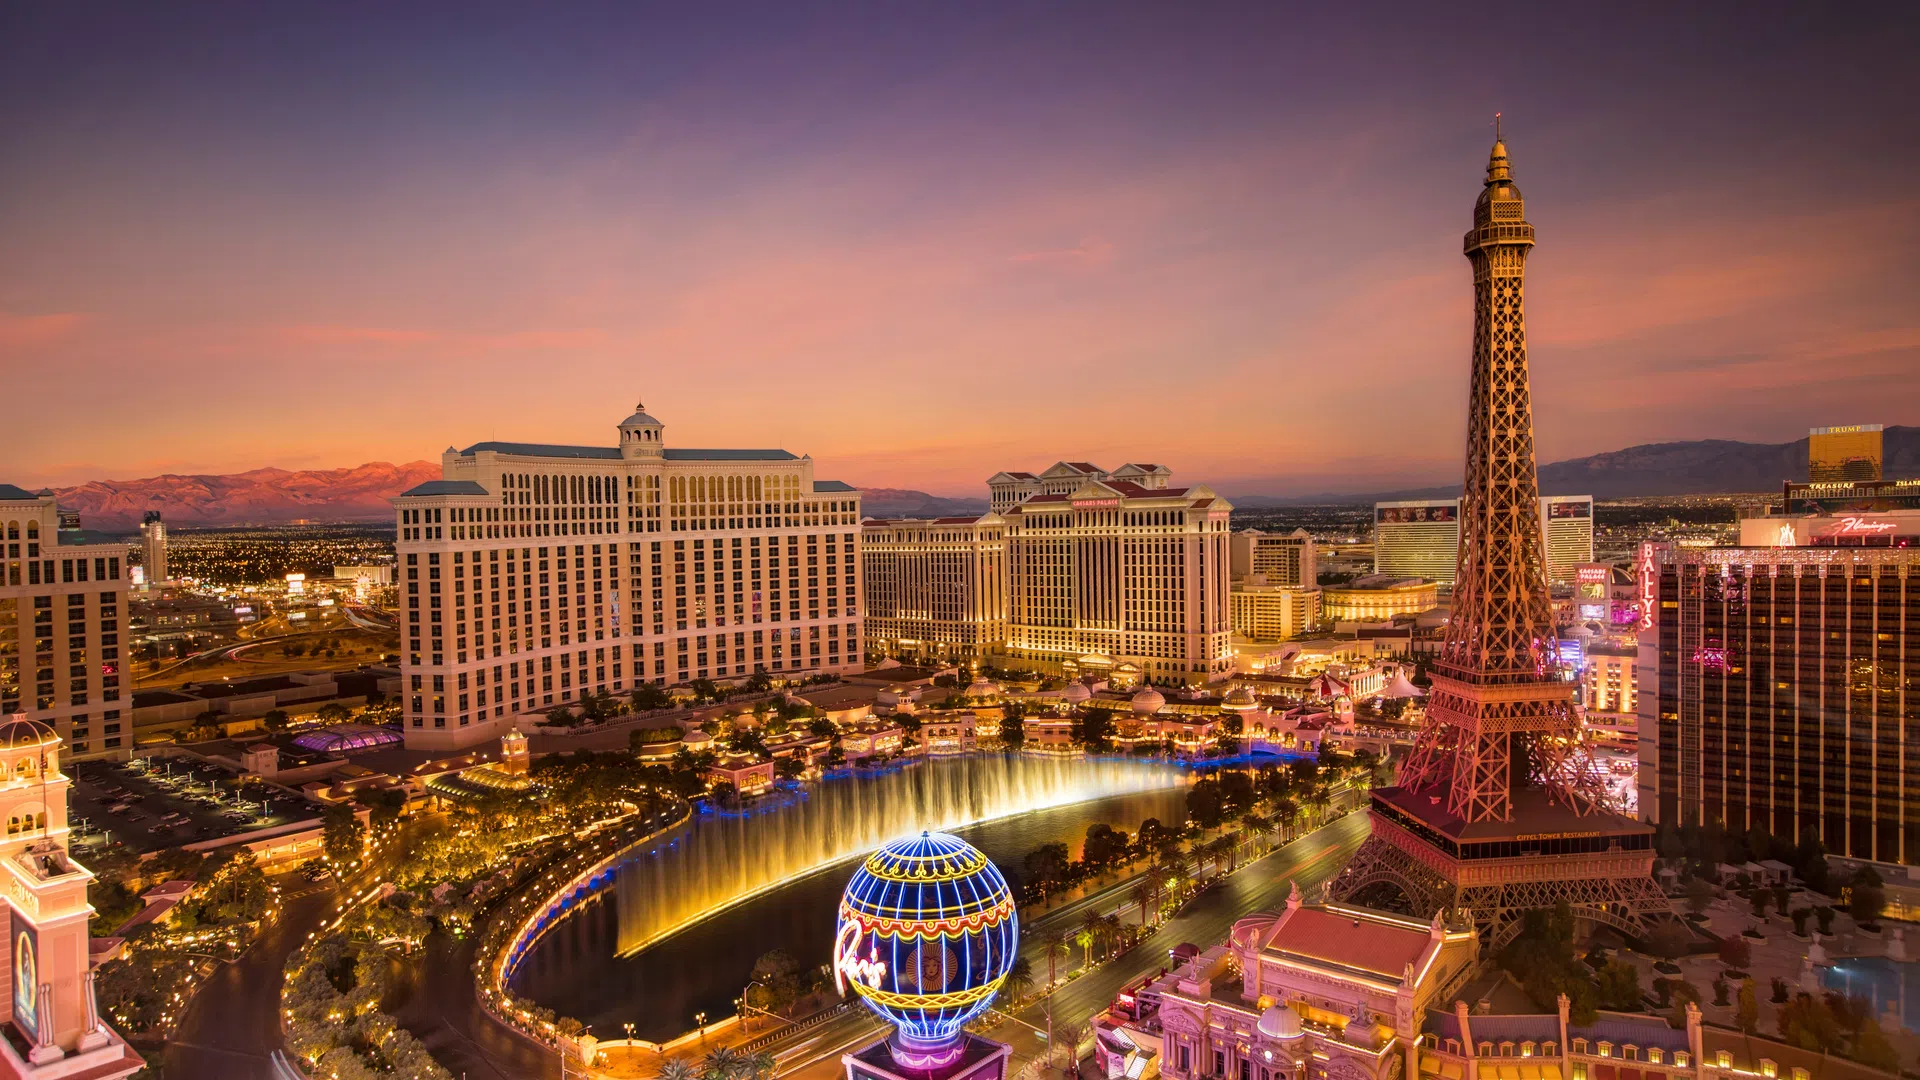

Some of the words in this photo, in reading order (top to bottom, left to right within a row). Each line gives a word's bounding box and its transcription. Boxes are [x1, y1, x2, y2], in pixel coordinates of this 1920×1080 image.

[1841, 517, 1897, 532] Flamingo
[1642, 543, 1654, 628] BALLYS
[834, 919, 887, 998] Paris
